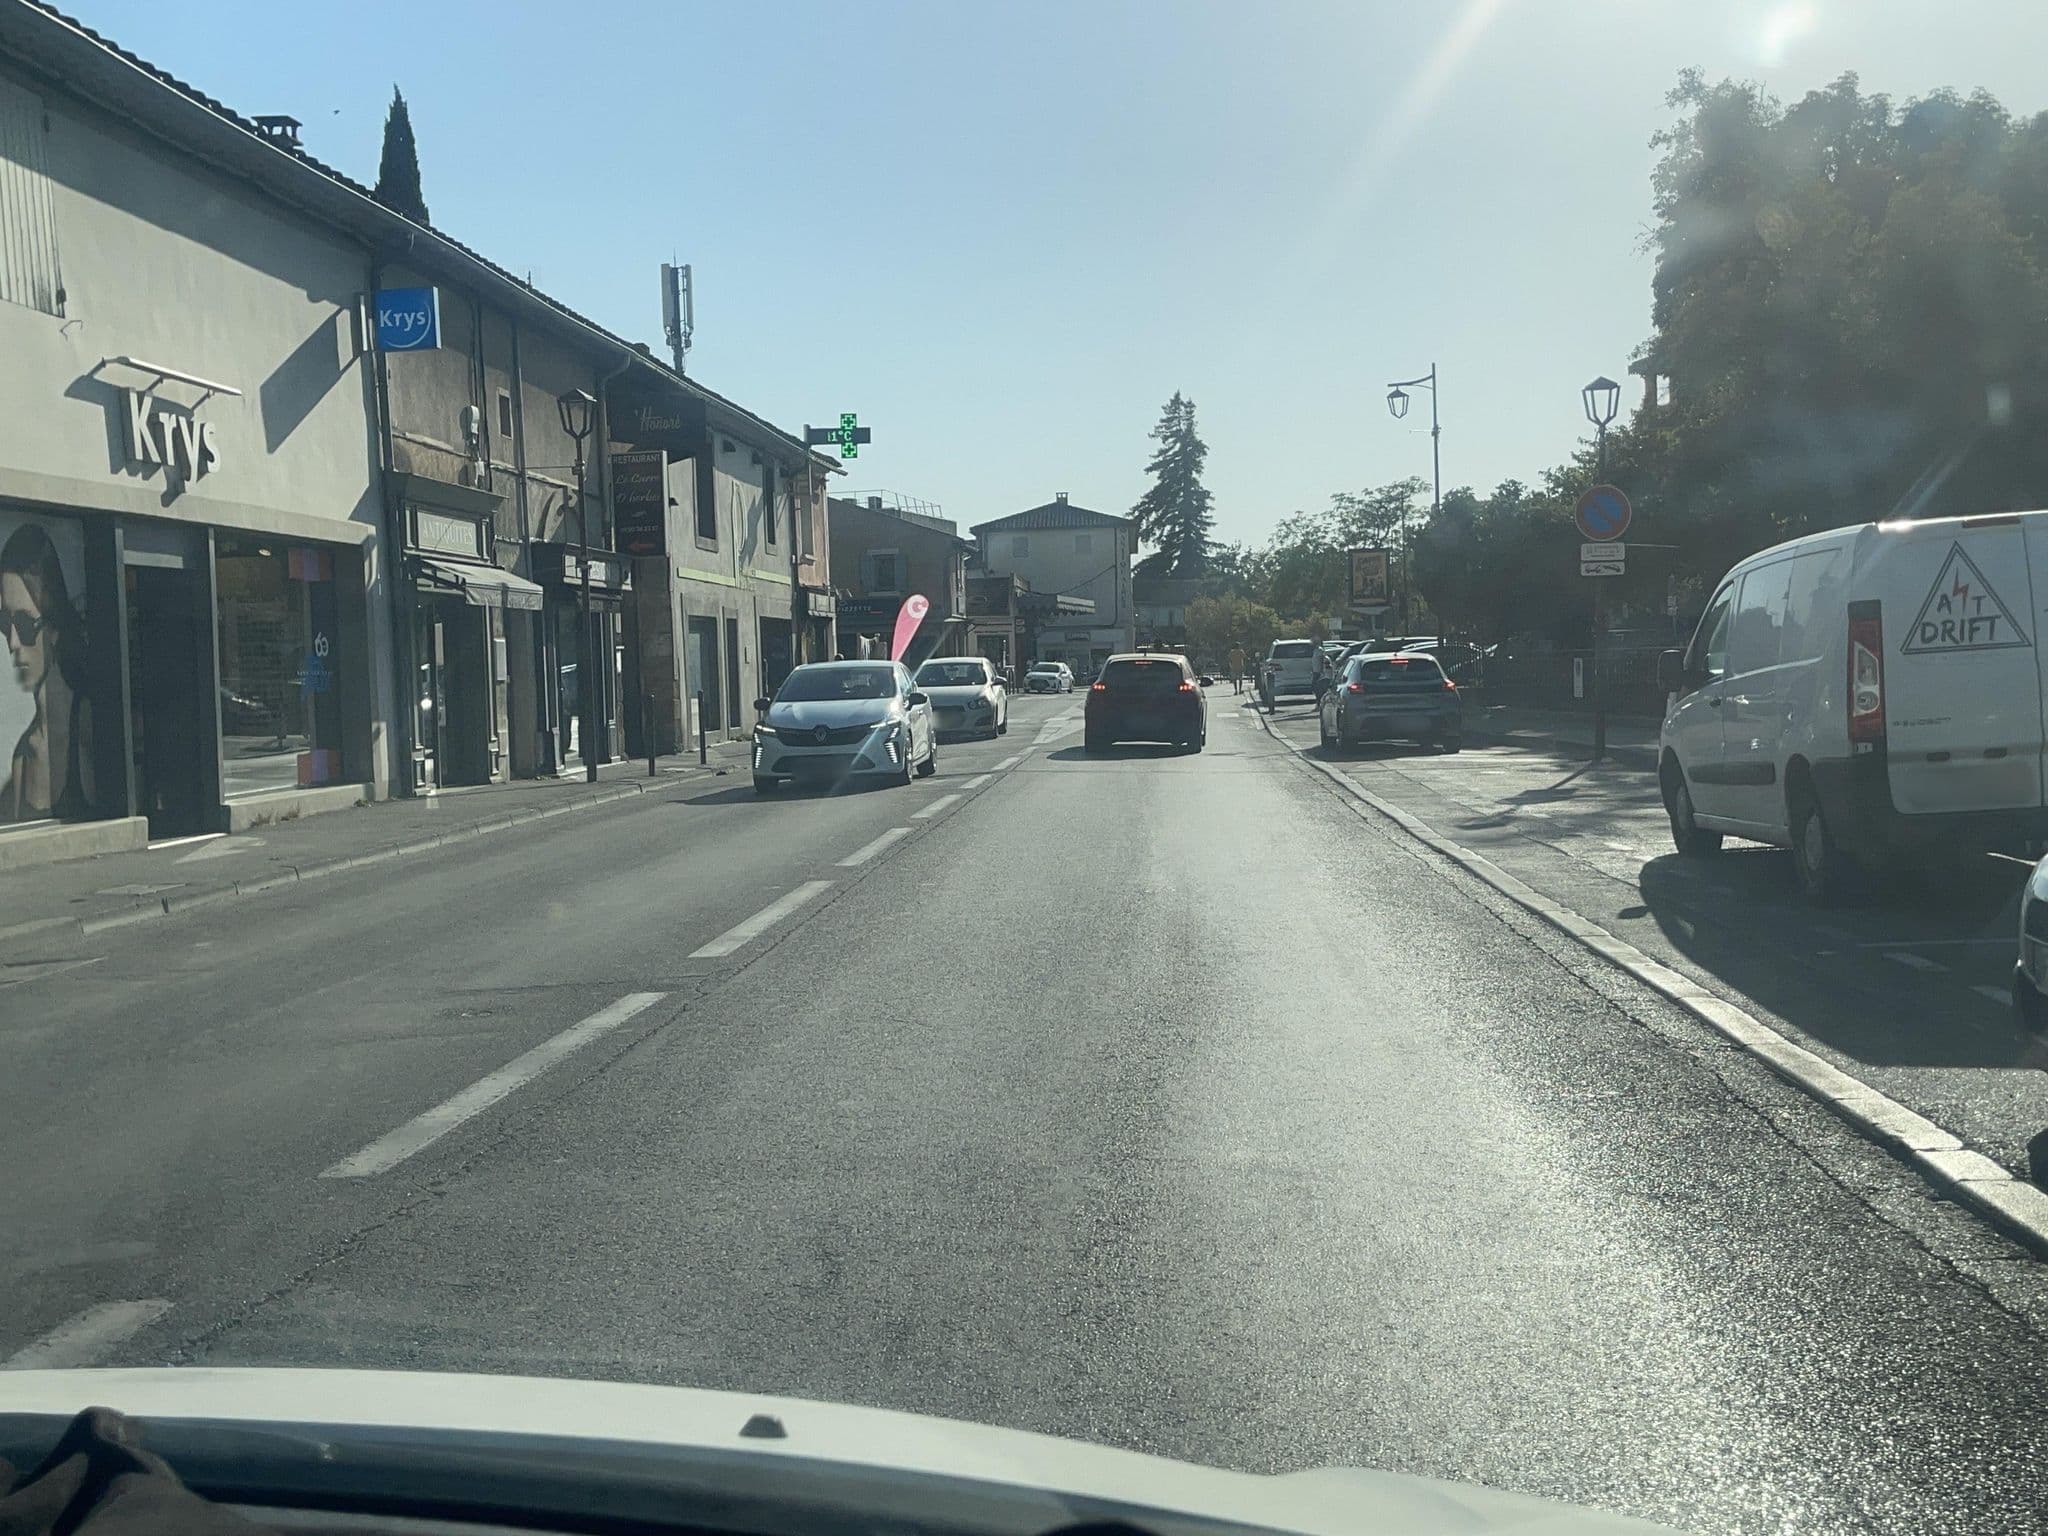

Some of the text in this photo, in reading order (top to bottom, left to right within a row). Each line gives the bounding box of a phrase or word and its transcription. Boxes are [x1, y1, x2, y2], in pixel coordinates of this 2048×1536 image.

[380, 309, 426, 332] Krys
[129, 387, 221, 494] Krys
[613, 453, 660, 464] RESTAURANT
[1920, 615, 2002, 645] DRIFT
